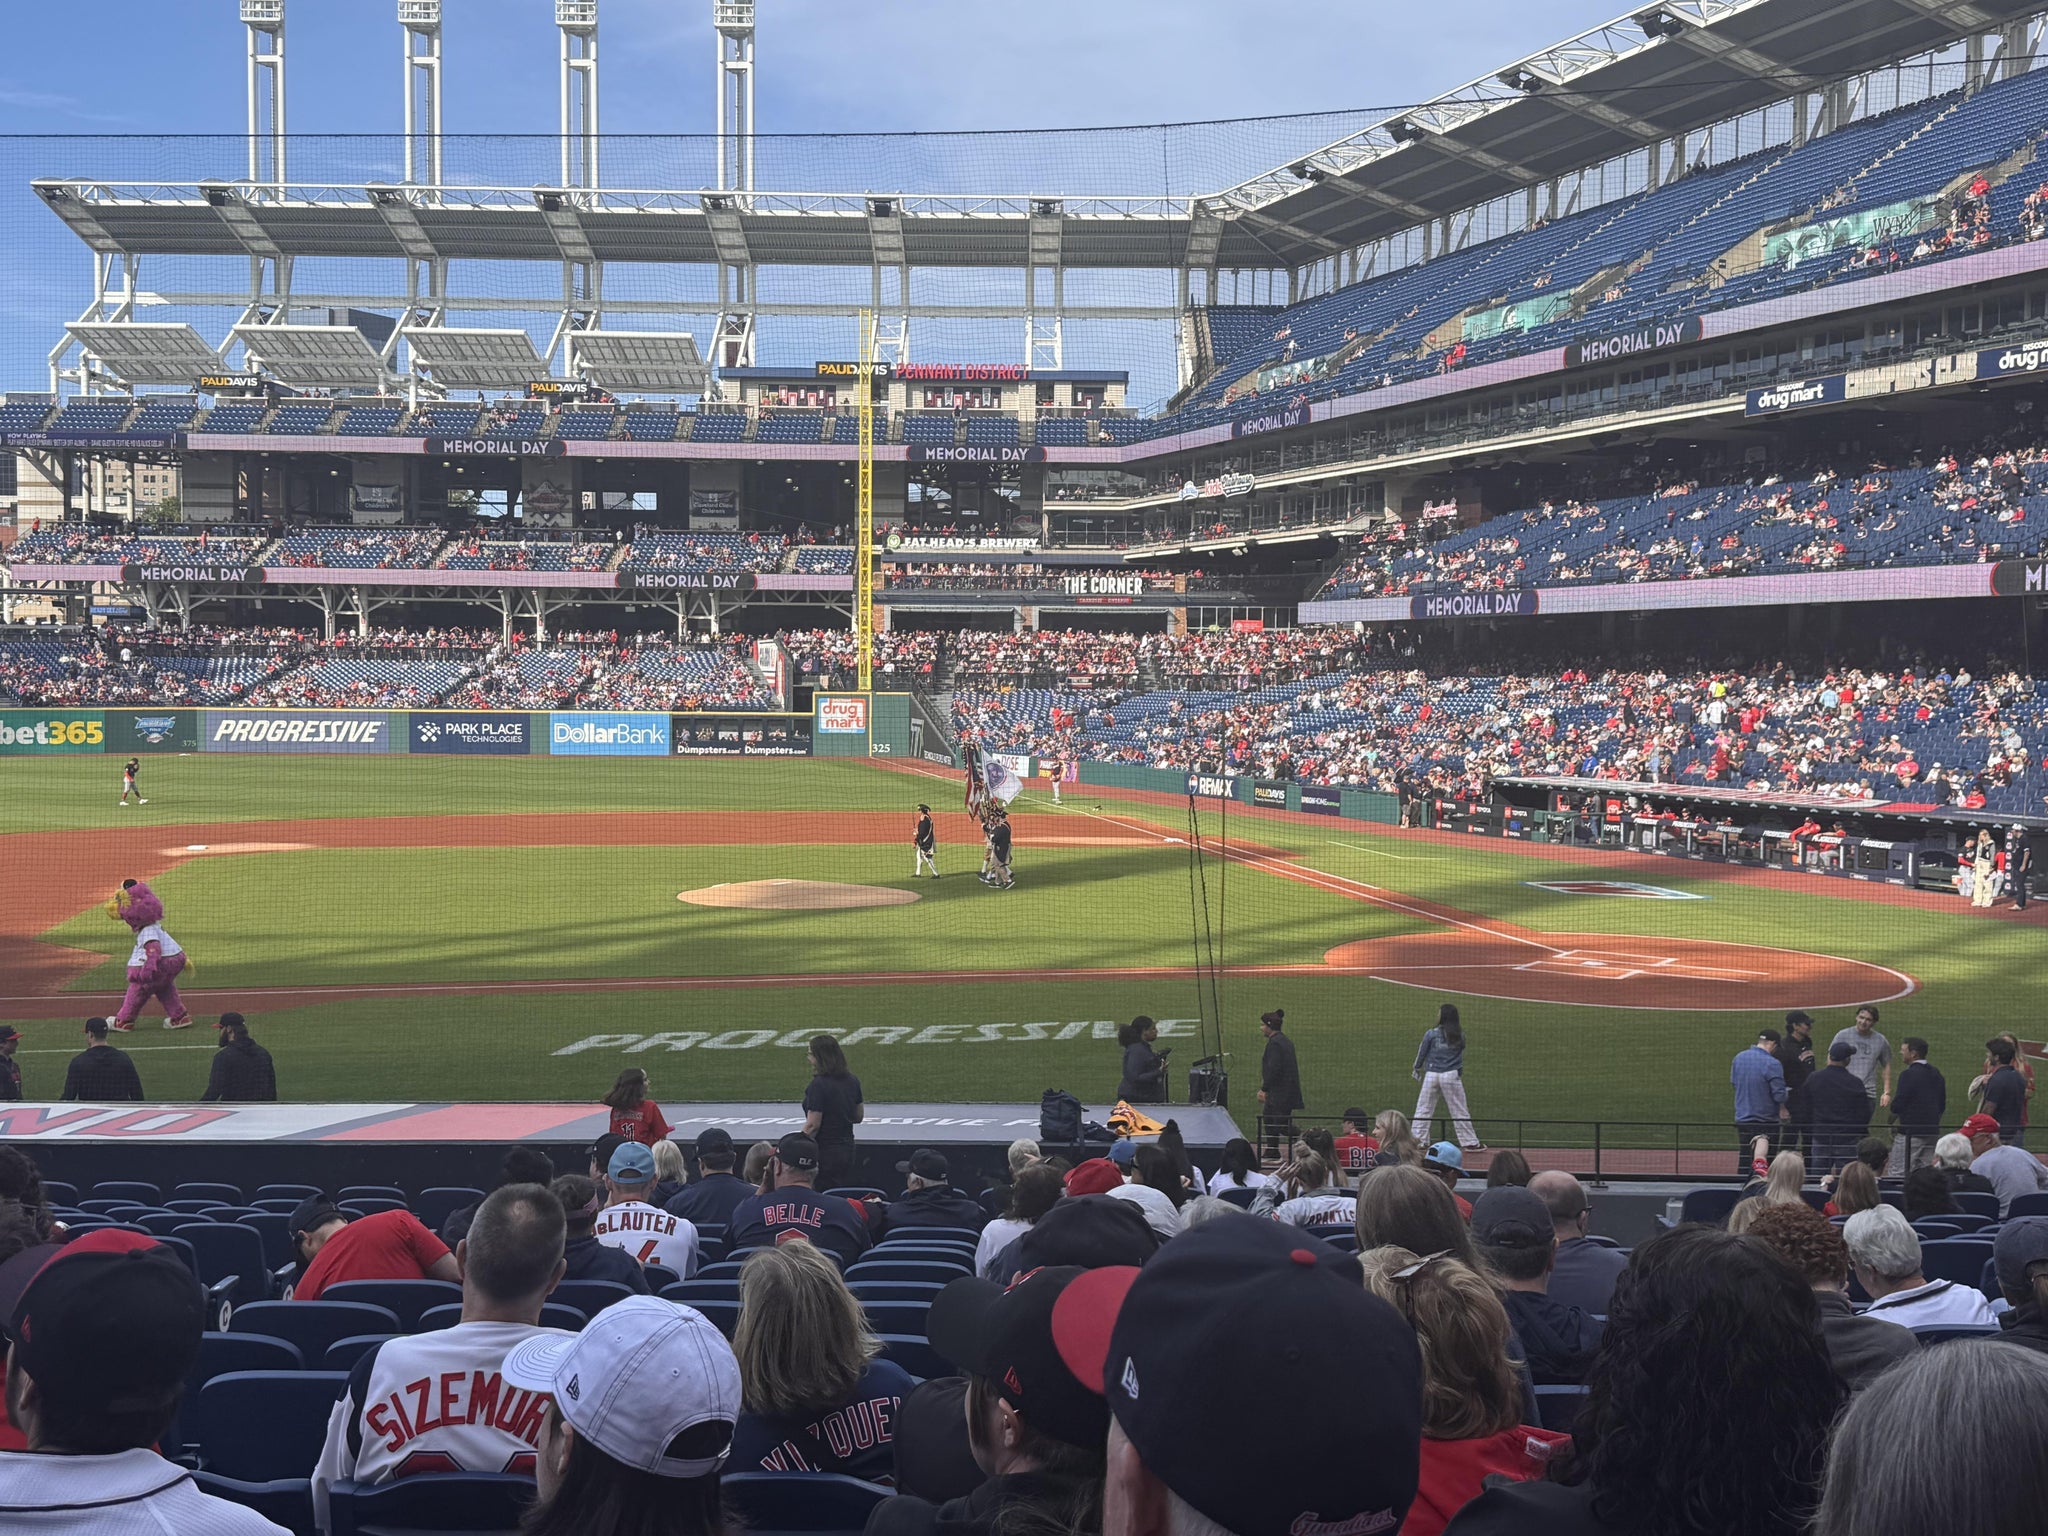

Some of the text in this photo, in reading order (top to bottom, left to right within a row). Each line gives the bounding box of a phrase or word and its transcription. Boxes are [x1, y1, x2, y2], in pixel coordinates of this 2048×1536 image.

[1581, 322, 1684, 363] MEMORIAL DAY
[1998, 350, 2039, 371] drug
[896, 363, 1029, 380] PENNANT DISTRICT
[1757, 383, 1824, 409] drug mart
[1241, 409, 1301, 436] MEMORIAL DAY
[444, 440, 551, 455] MEMORIAL DAY
[926, 447, 1027, 460] MEMORIAL DAY
[904, 538, 1039, 548] FAT HEAD'S BREWERY
[141, 567, 248, 581] MEMORIAL DAY
[635, 574, 740, 588] MEMORIAL DAY
[1064, 577, 1143, 594] THE CORNER
[1426, 593, 1522, 616] MEMORIAL DAY
[823, 700, 858, 718] drug
[213, 719, 382, 743] PROGRESSIVE
[445, 723, 523, 735] PARK PLACE
[826, 718, 865, 728] mart
[0, 720, 103, 745] bet365
[462, 735, 523, 743] TECHNOLOGIES
[872, 744, 890, 752] 325
[1604, 824, 1620, 832] TOYOT
[551, 1018, 1202, 1056] PROGRESSIVE
[675, 1116, 999, 1127] PROGESSIVE
[763, 1203, 825, 1228] BELLE
[366, 1370, 550, 1453] SIZEMOR
